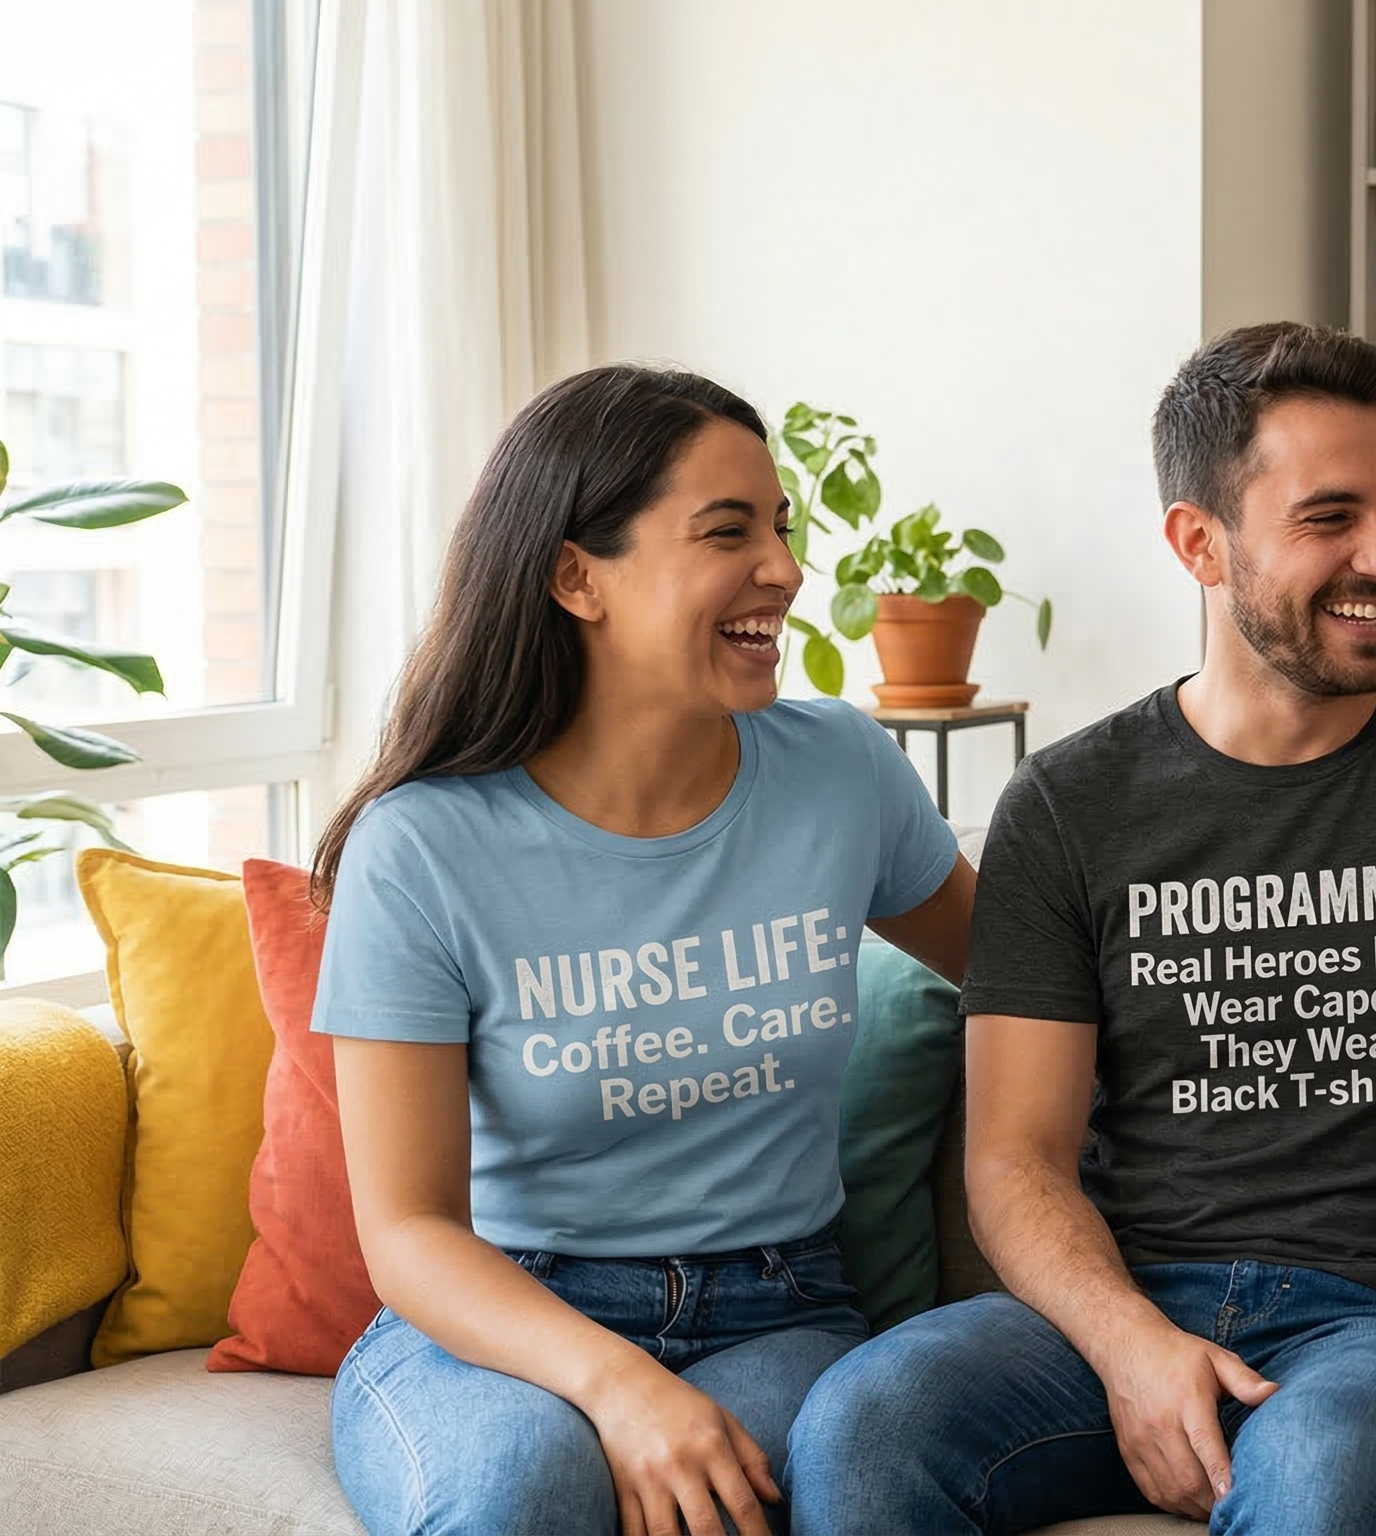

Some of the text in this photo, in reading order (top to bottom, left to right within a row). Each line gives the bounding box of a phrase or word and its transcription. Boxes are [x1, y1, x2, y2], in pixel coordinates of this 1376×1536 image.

[515, 907, 850, 1020] NURSE LIFE:
[1130, 948, 1212, 986] Real
[1225, 945, 1361, 981] Heroes
[1183, 991, 1283, 1026] Wear
[522, 996, 852, 1077] Coffee. Care.
[1200, 1033, 1297, 1073] They
[600, 1053, 795, 1121] Repeat.
[1172, 1076, 1280, 1114] Black
